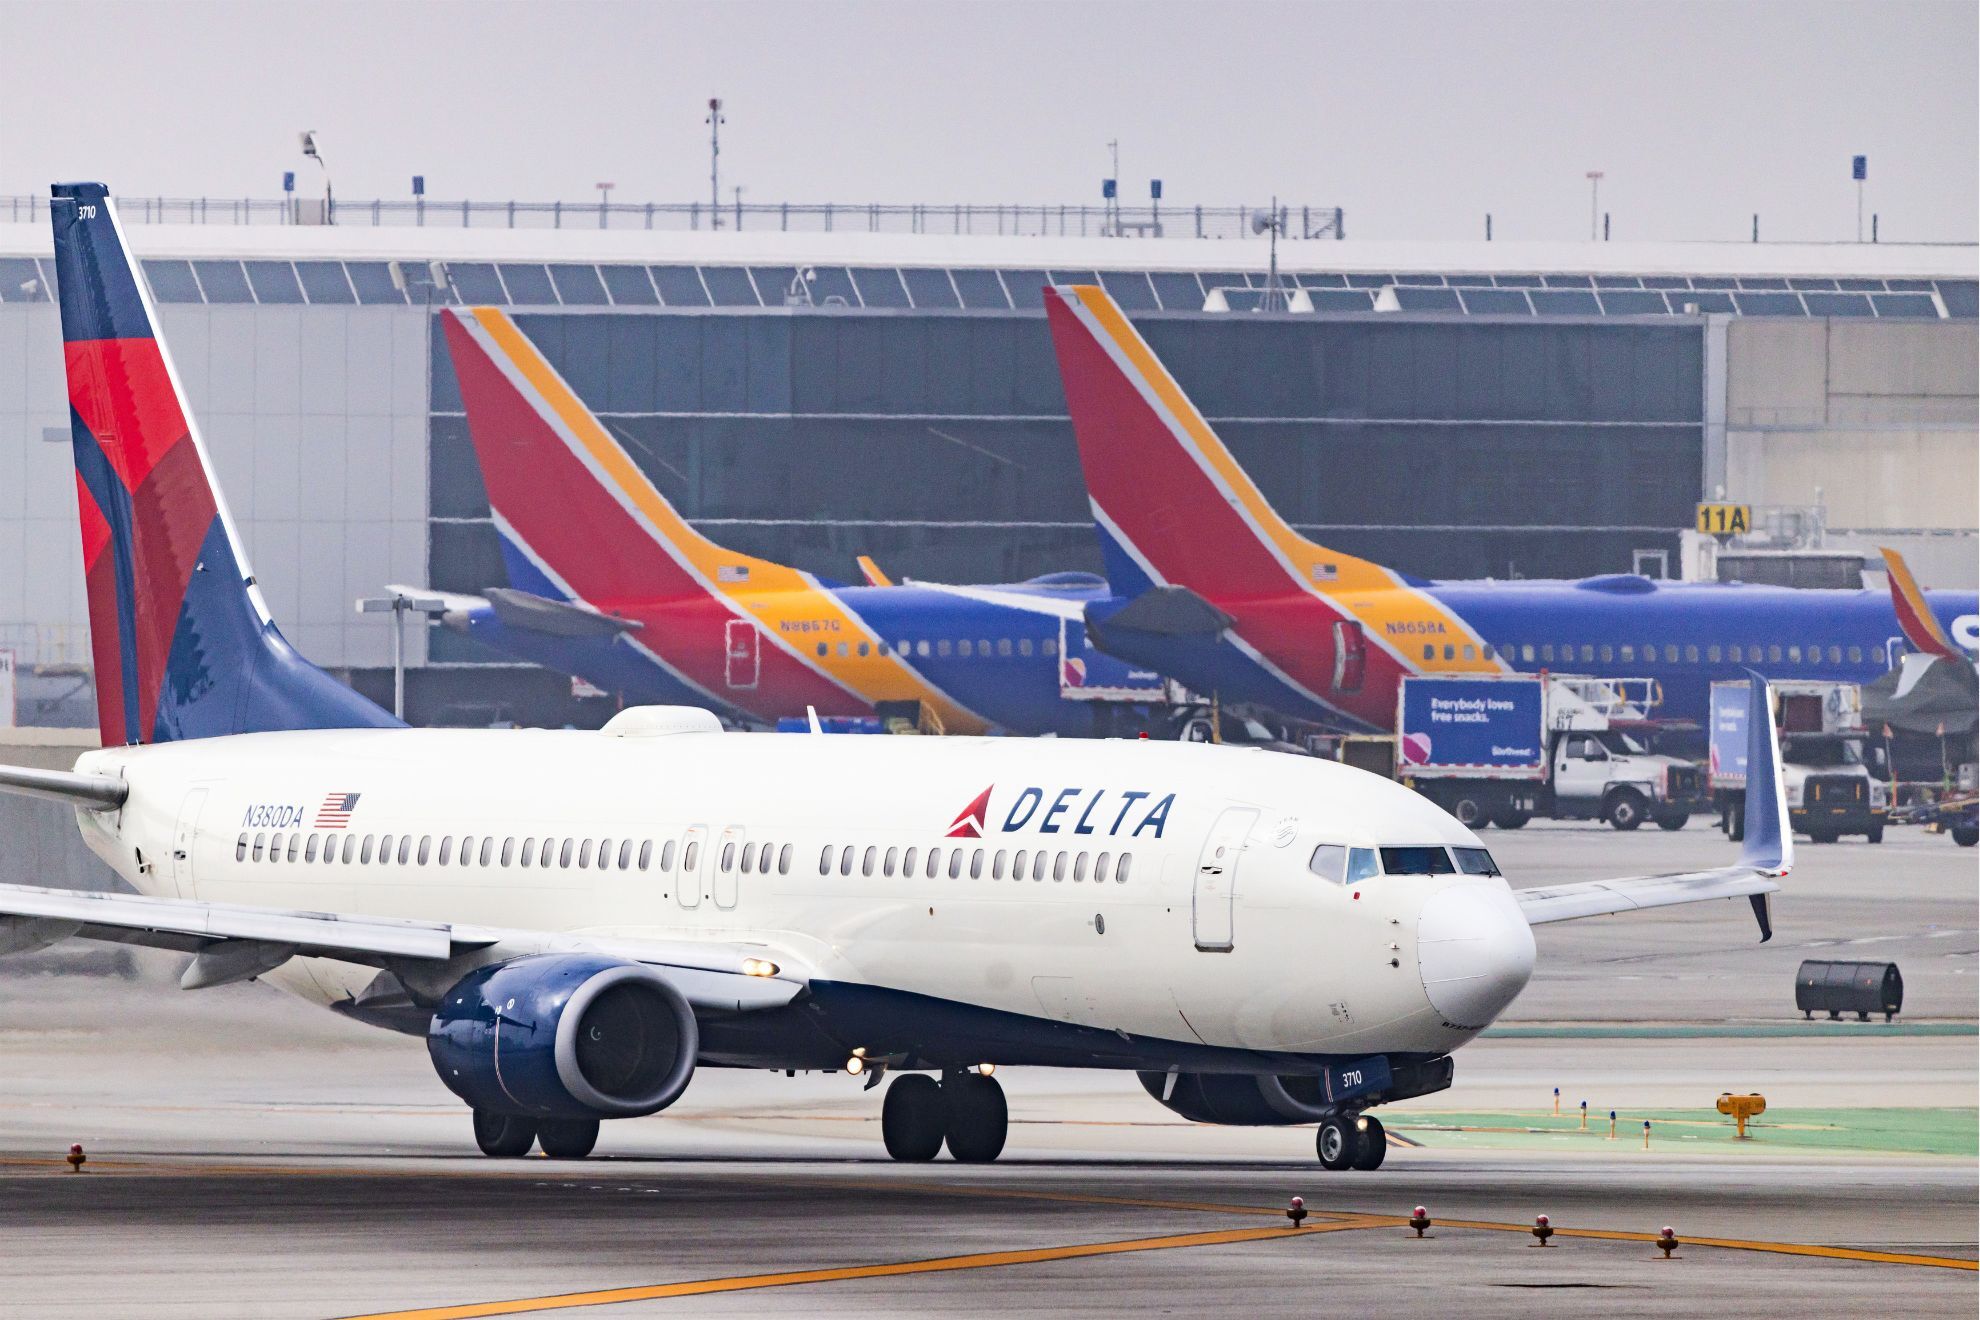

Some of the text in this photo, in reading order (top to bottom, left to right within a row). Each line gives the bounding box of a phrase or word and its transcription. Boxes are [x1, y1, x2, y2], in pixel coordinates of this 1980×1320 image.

[78, 205, 96, 220] 3710
[1701, 507, 1746, 531] 11A
[1431, 698, 1514, 711] Everybody loves
[1431, 710, 1490, 722] free snacks.
[242, 804, 304, 828] N380DA
[1001, 787, 1177, 838] DELTA
[1342, 1070, 1362, 1088] 3710
